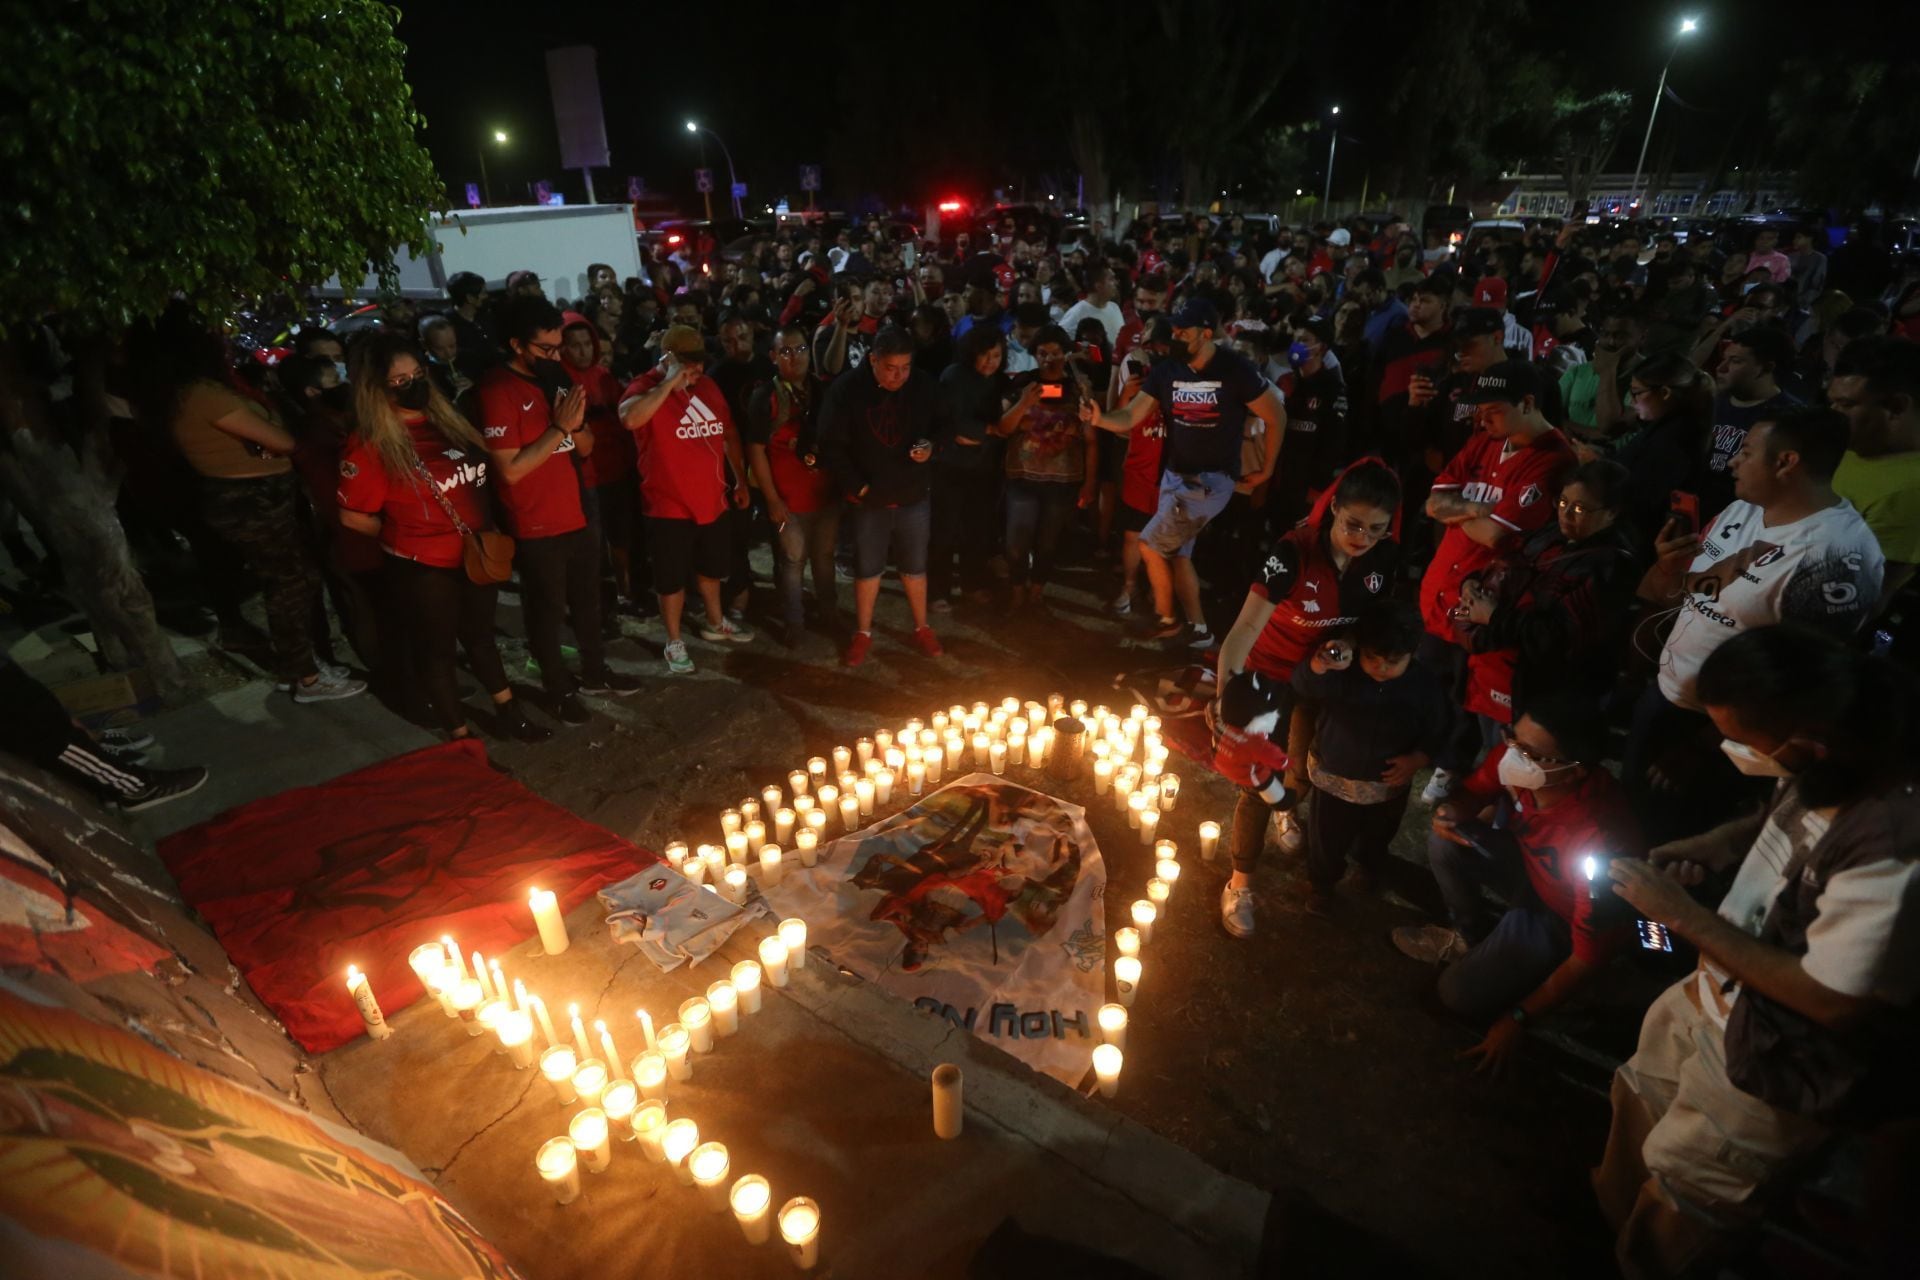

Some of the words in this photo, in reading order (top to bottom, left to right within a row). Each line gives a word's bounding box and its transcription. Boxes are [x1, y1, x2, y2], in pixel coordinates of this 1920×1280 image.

[1172, 390, 1218, 404] RUSSIA
[484, 426, 508, 438] SKY
[675, 421, 723, 439] adidas
[435, 462, 486, 492] wibe
[1694, 600, 1736, 627] Azteca
